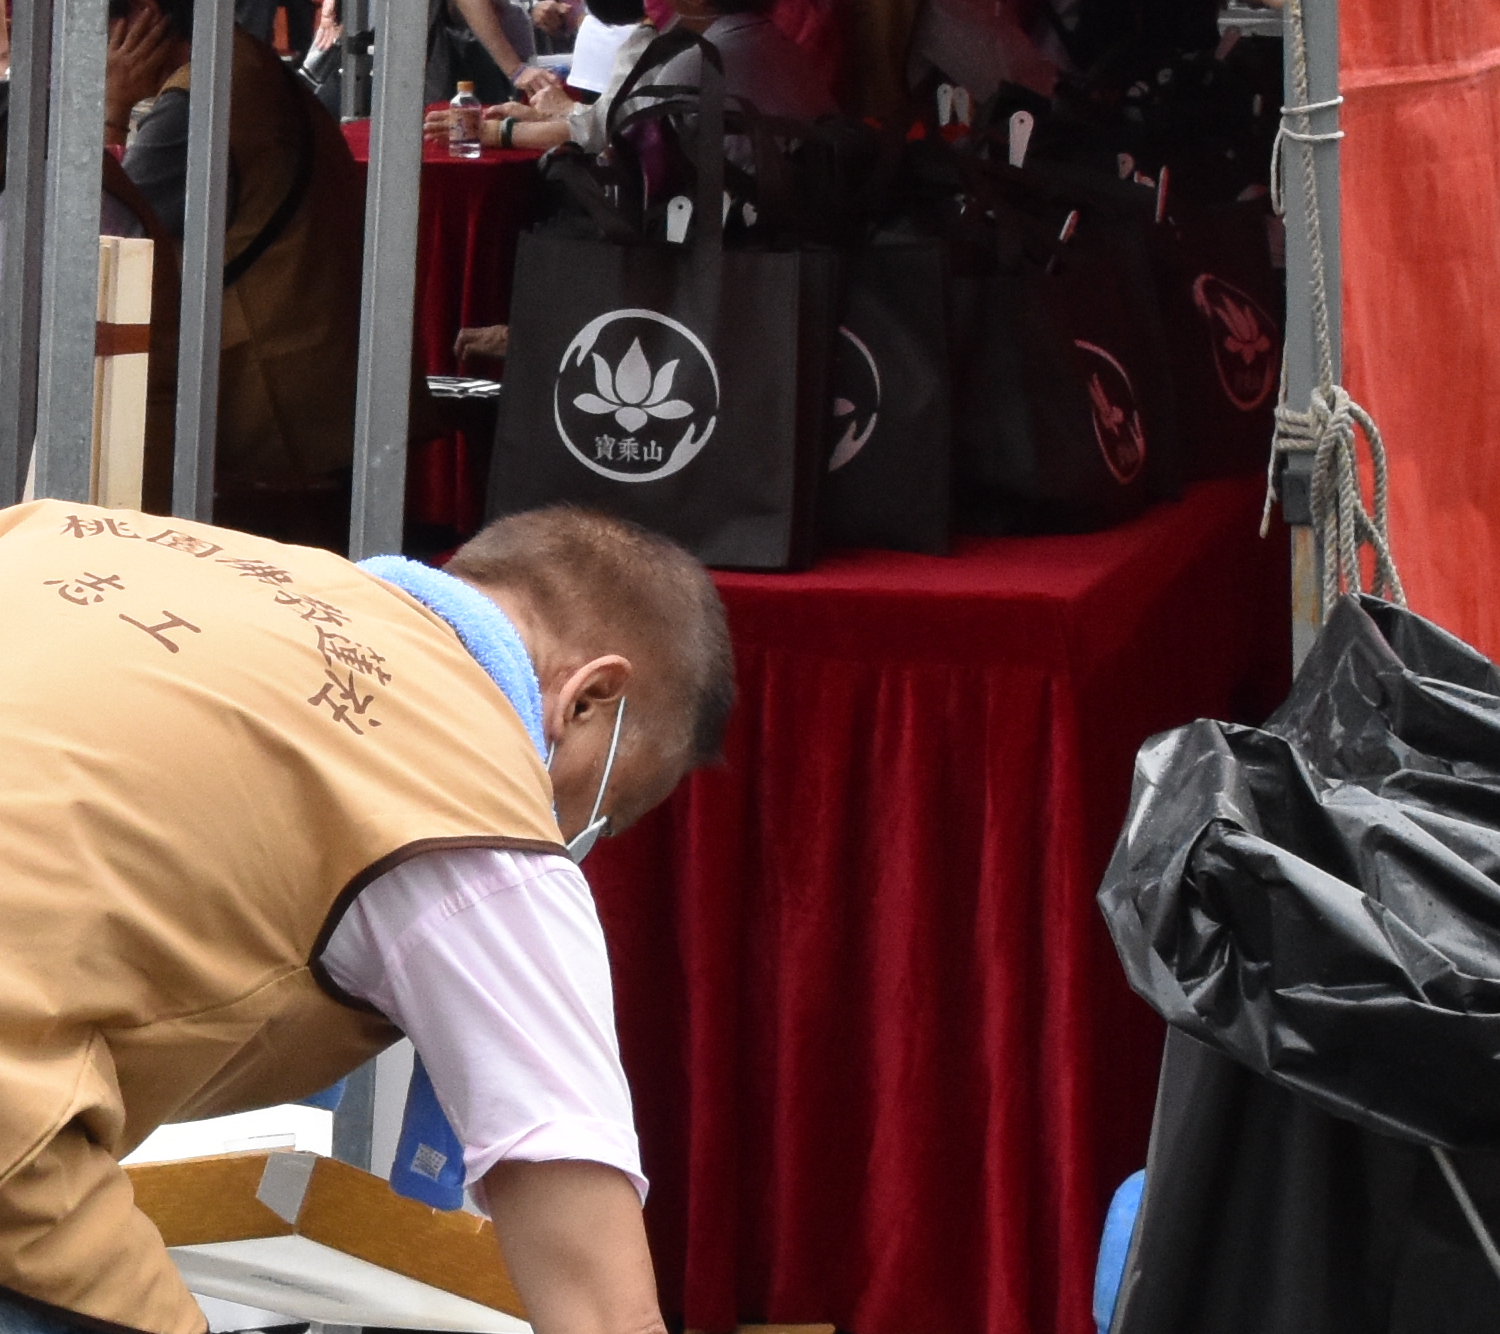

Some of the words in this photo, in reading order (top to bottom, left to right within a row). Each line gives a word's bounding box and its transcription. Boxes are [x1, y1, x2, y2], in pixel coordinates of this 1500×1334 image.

[593, 433, 663, 462] 寶乘山
[43, 571, 203, 655] 志工
